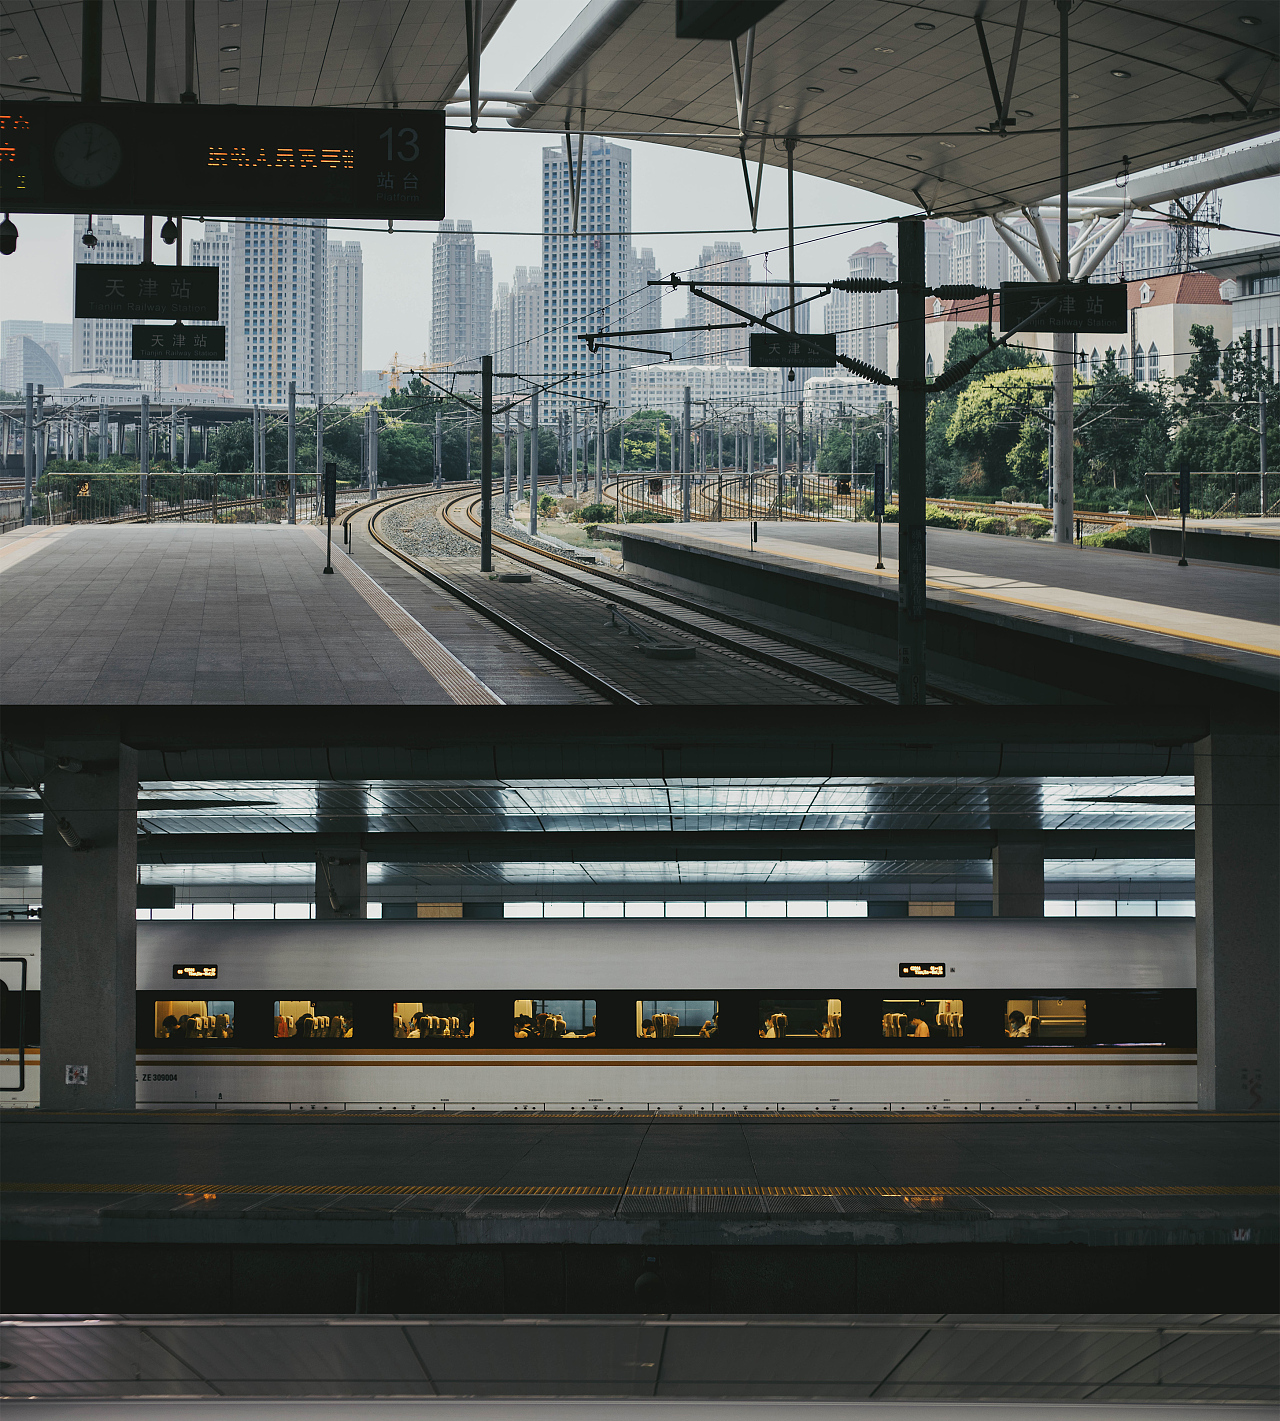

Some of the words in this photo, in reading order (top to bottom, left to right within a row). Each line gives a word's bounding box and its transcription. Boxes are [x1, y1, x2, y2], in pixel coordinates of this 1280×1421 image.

[380, 127, 420, 162] 13
[377, 172, 419, 190] 站台
[376, 193, 420, 201] Platform
[105, 278, 192, 299] 天津站
[89, 302, 122, 312] Tianjin
[127, 302, 167, 313] Railway
[172, 304, 207, 312] Station
[1030, 295, 1104, 315] 天津站
[1017, 317, 1045, 327] Tnjin
[1049, 318, 1083, 328] Railway
[1087, 319, 1118, 327] Station
[151, 334, 207, 348] 天津站
[142, 1074, 152, 1082] ZE
